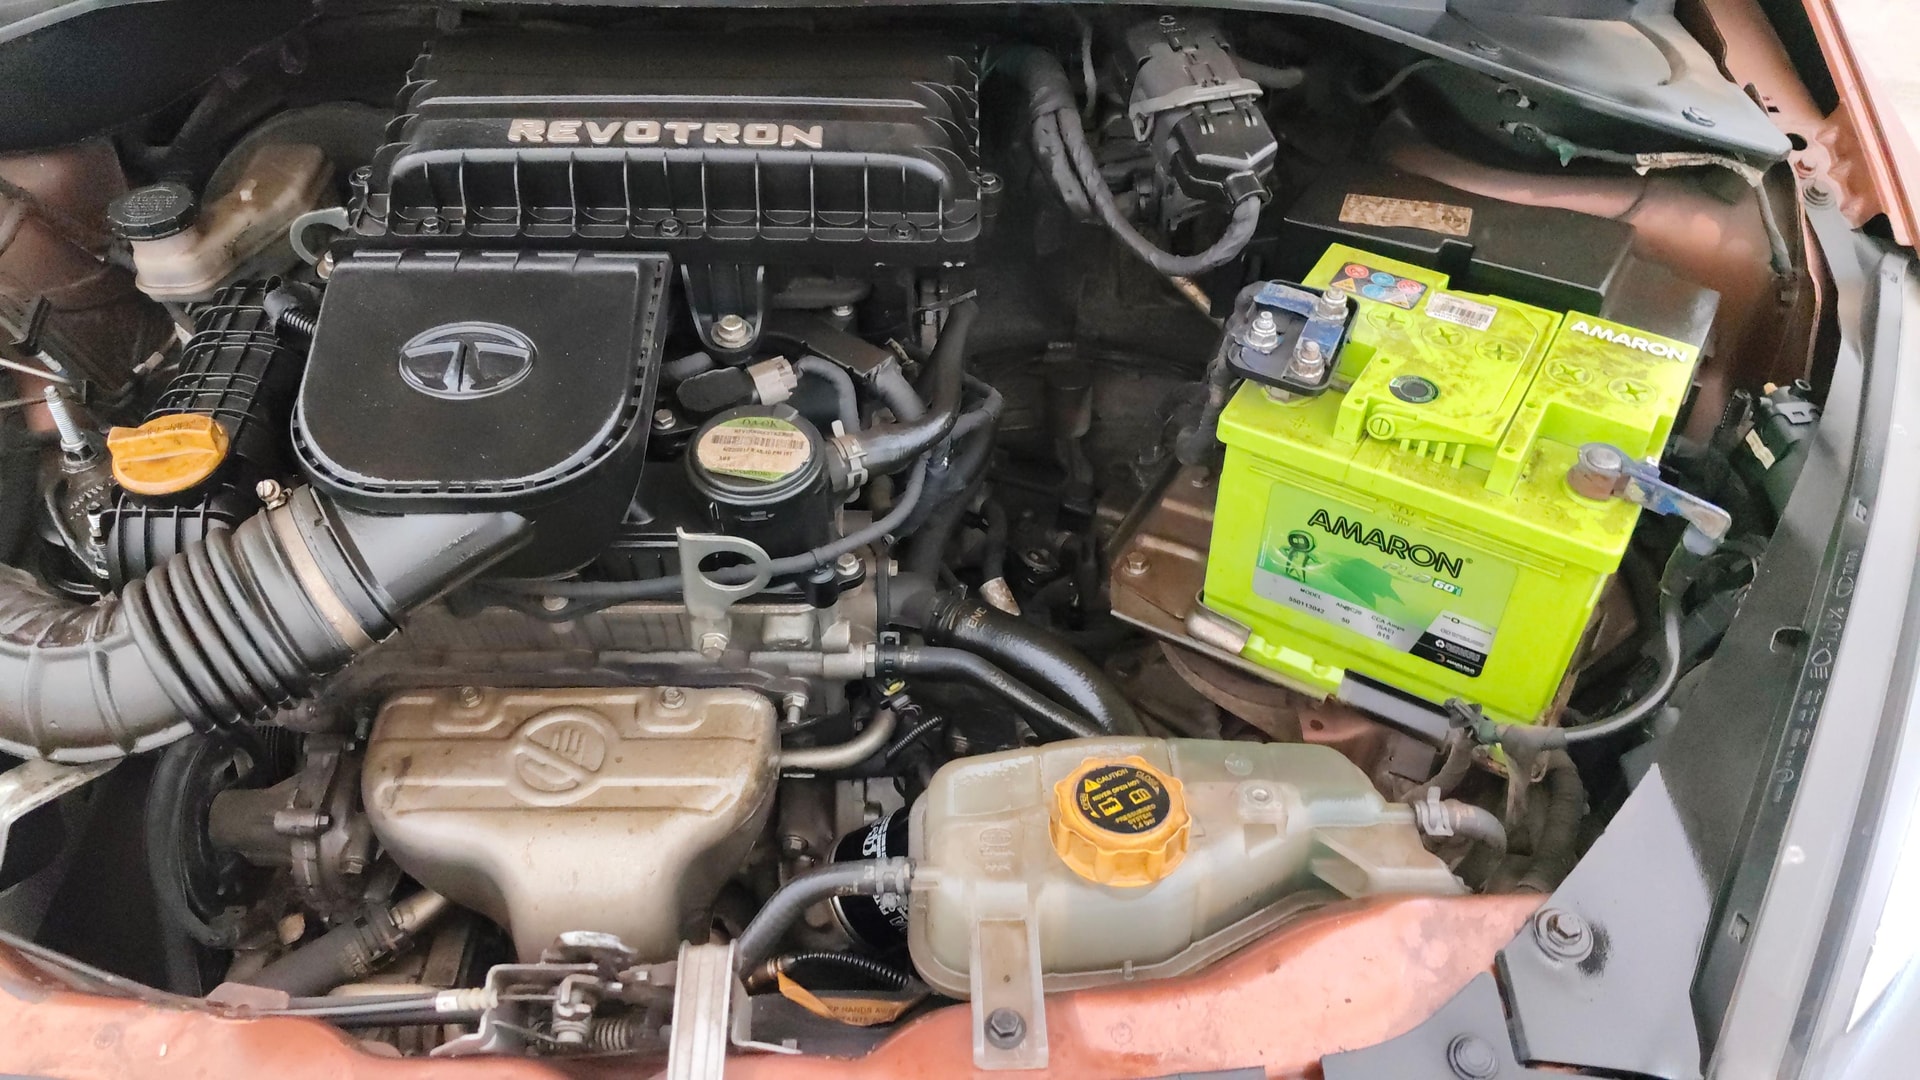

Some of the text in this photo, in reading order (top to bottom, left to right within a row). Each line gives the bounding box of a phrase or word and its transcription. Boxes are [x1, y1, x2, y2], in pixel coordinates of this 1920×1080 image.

[507, 118, 823, 148] REVOTRON
[1570, 321, 1688, 362] AMARON
[1307, 508, 1464, 579] AMARON
[1300, 588, 1321, 600] MODEL
[1096, 768, 1128, 784] CAUTION
[1092, 790, 1112, 801] NEVER
[1112, 784, 1128, 793] OPEN
[842, 1005, 872, 1014] HANDS
